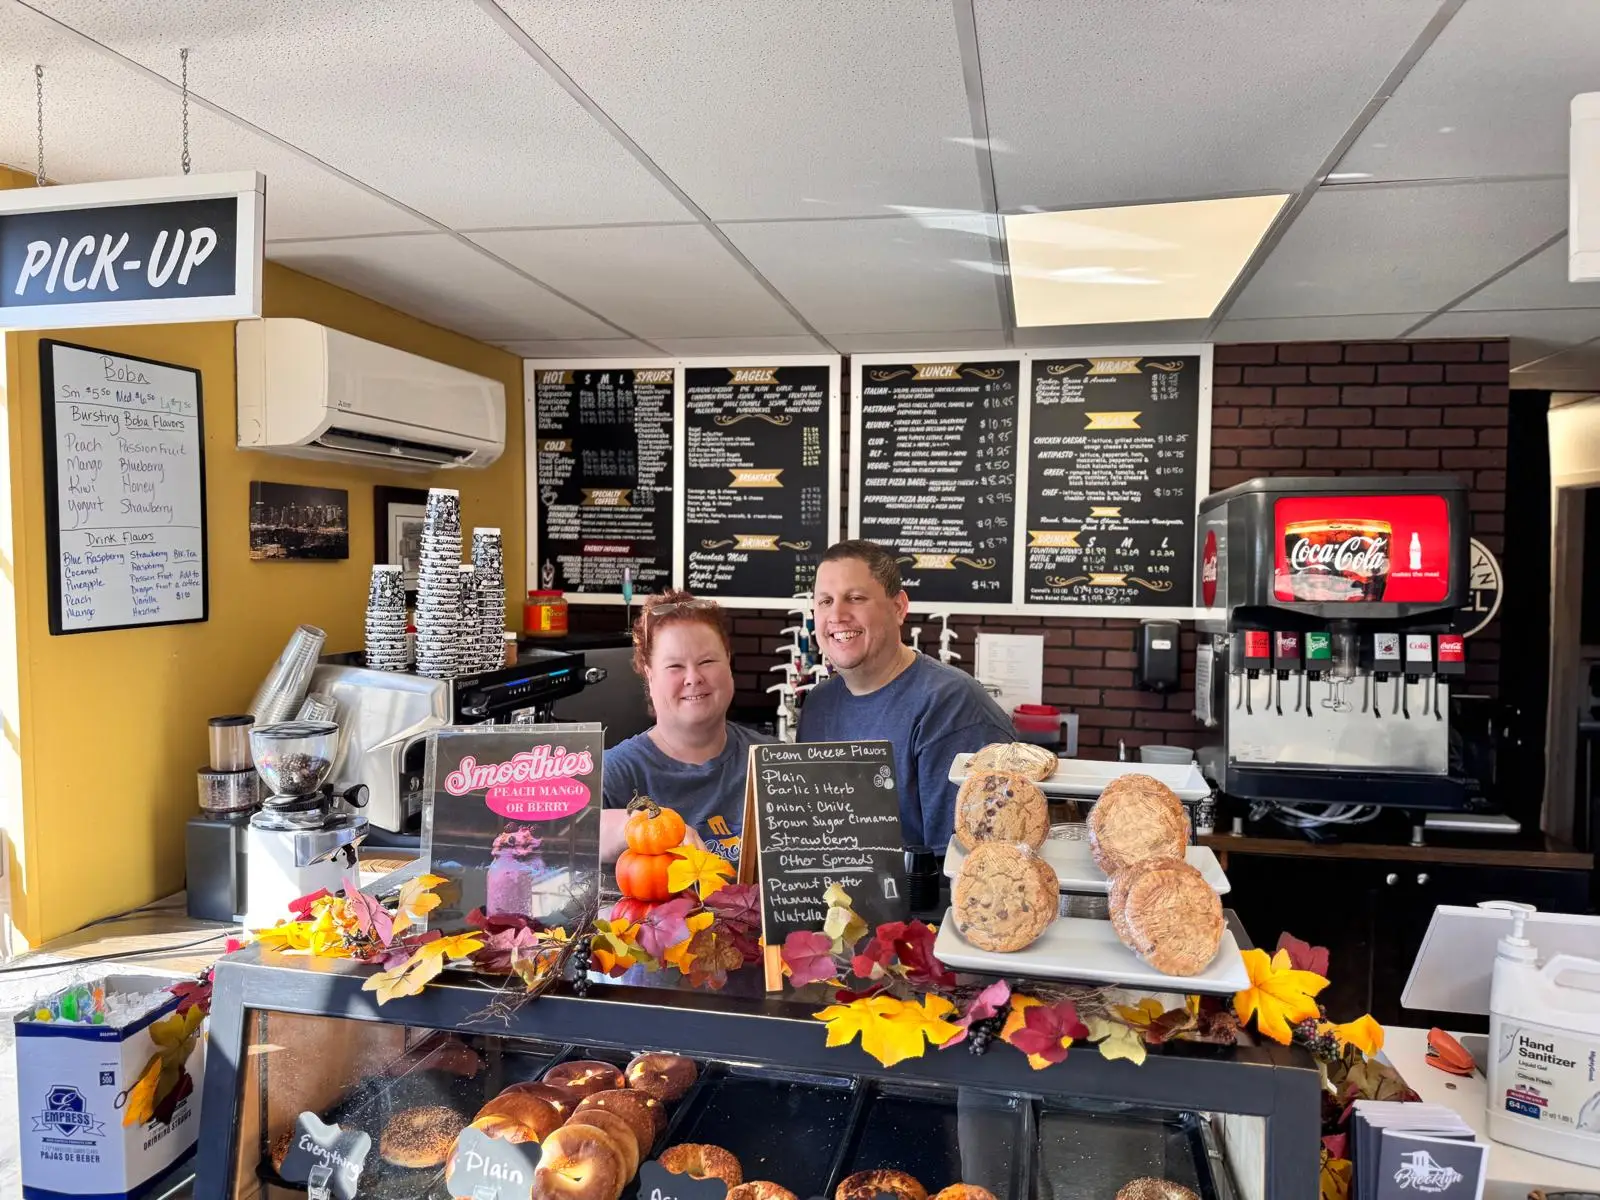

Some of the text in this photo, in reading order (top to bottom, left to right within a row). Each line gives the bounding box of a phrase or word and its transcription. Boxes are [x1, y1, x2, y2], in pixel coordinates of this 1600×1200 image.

[14, 227, 218, 296] PICK-UP
[100, 356, 150, 384] Boba
[920, 366, 953, 377] LUNCH
[1096, 361, 1135, 372] WRAPS
[543, 371, 565, 384] HOT
[585, 374, 624, 384] S M L
[635, 370, 672, 381] SYRUPS
[735, 370, 773, 381] BAGELS
[864, 387, 888, 395] ITALIAN
[70, 405, 185, 436] Bursting Boba Flavors
[64, 432, 102, 452] Peach
[544, 441, 566, 451] COLD
[867, 438, 885, 446] CLUB
[1033, 436, 1061, 444] CHICKEN
[1061, 436, 1087, 444] CAESAR
[117, 436, 187, 457] Passion Fruit
[1037, 451, 1073, 459] ANTIPASTO
[67, 455, 102, 481] Mango
[1043, 468, 1065, 476] GREEK
[738, 472, 777, 482] BREAKFAST
[865, 478, 906, 486] CHEESE PIZZA
[68, 474, 95, 494] Kiwi
[122, 473, 155, 502] Honey
[591, 491, 621, 499] SPECIALTY
[1041, 488, 1058, 496] CHEF
[864, 495, 899, 503] PEPPERONI
[899, 495, 917, 503] PIZZA
[84, 532, 117, 546] Drink
[742, 540, 772, 548] DRINKS
[1087, 536, 1169, 548] S M L
[63, 551, 82, 567] Blue
[130, 551, 168, 562] Strawberry
[689, 552, 749, 562] Chocolate Milk
[1291, 535, 1388, 571] Coca-Cola
[688, 562, 715, 572] Orange
[918, 555, 948, 568] SIDES
[1029, 562, 1043, 570] ICED
[65, 566, 99, 579] Coconut
[688, 572, 713, 582] Apple
[689, 580, 704, 589] Hot
[971, 580, 1001, 590] $4.79
[65, 594, 92, 606] Peach
[66, 607, 96, 621] Mango
[1409, 642, 1430, 650] Coke
[761, 745, 887, 761] Cream Cheese Flavors
[445, 744, 594, 796] Smoothies
[761, 769, 806, 784] Plain
[493, 783, 584, 797] PEACH MANGO
[766, 784, 855, 795] Garlic Herb
[505, 801, 569, 813] OR BERRY
[766, 802, 854, 813] Onion Chive
[765, 814, 899, 833] Brown Sugar Cinnamon
[770, 832, 858, 848] Strawberry
[780, 853, 874, 869] Other Spreads
[767, 876, 821, 892] Peanut
[770, 895, 827, 905] Hummu
[774, 911, 825, 923] Nutella
[1519, 1036, 1554, 1053] Hand
[1518, 1047, 1577, 1068] Sanitizer
[1518, 1059, 1537, 1069] Liquid
[101, 1075, 114, 1085] 500
[1508, 1100, 1521, 1109] 64
[44, 1111, 91, 1126] EMPRESS
[143, 1125, 171, 1151] DRINKING
[40, 1151, 101, 1163] PAJAS DE BEBER
[298, 1133, 361, 1181] Everything
[464, 1150, 524, 1186] Plain
[1393, 1166, 1464, 1191] Brooklyn
